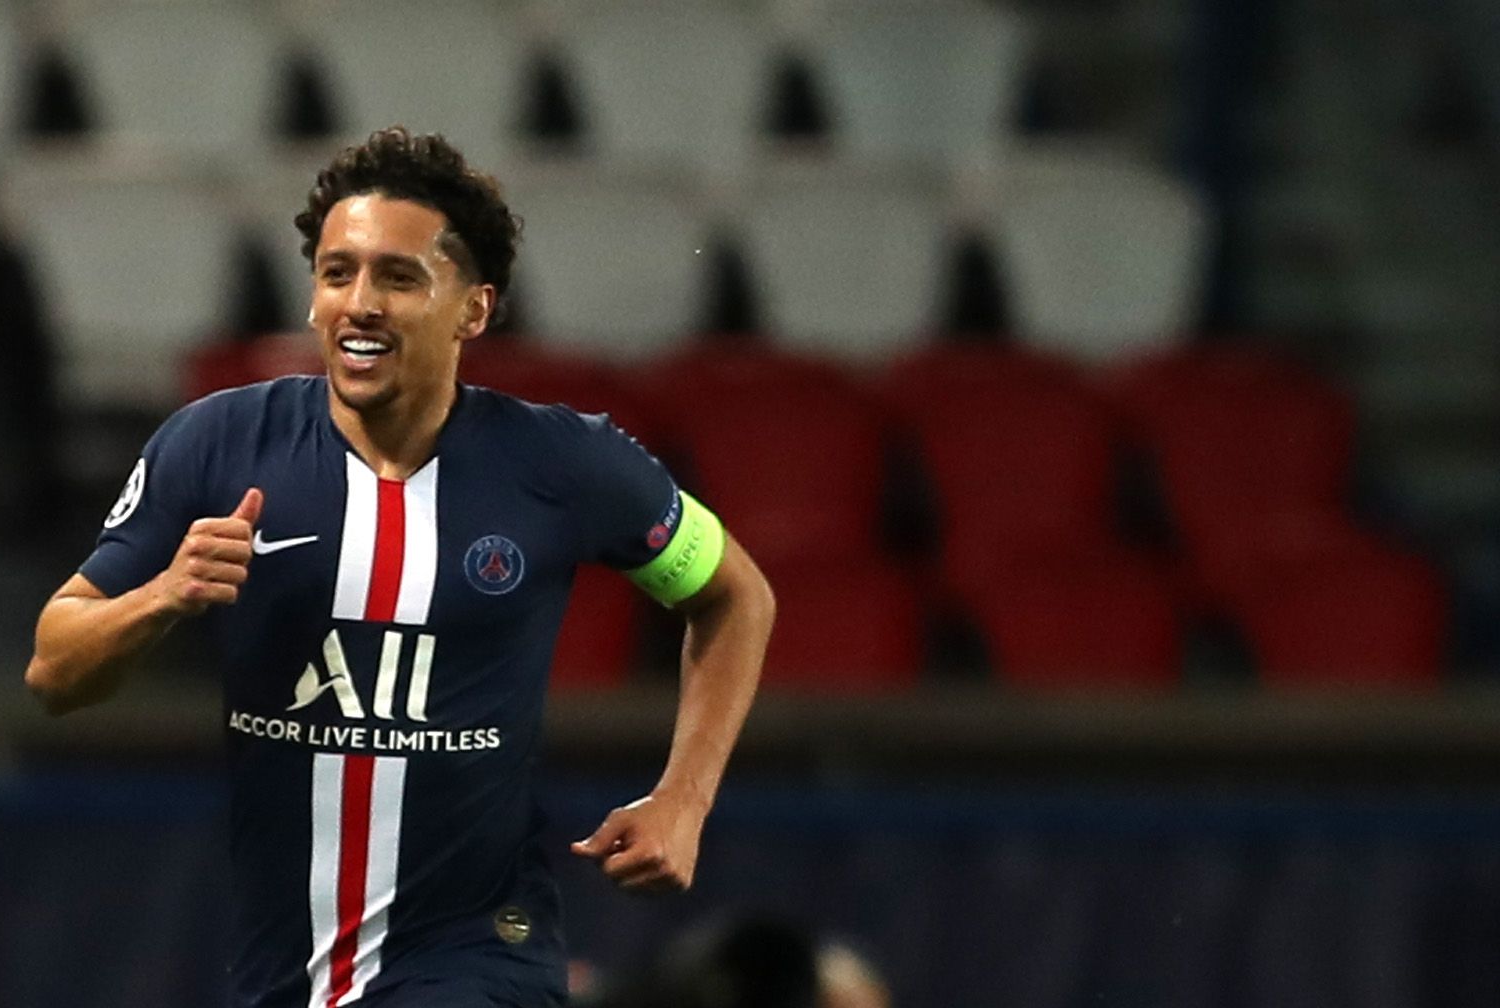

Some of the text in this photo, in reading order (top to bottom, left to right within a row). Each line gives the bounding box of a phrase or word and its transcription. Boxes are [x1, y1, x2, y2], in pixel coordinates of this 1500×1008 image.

[229, 710, 500, 752] ACCOR LIVE LIMITLESS
